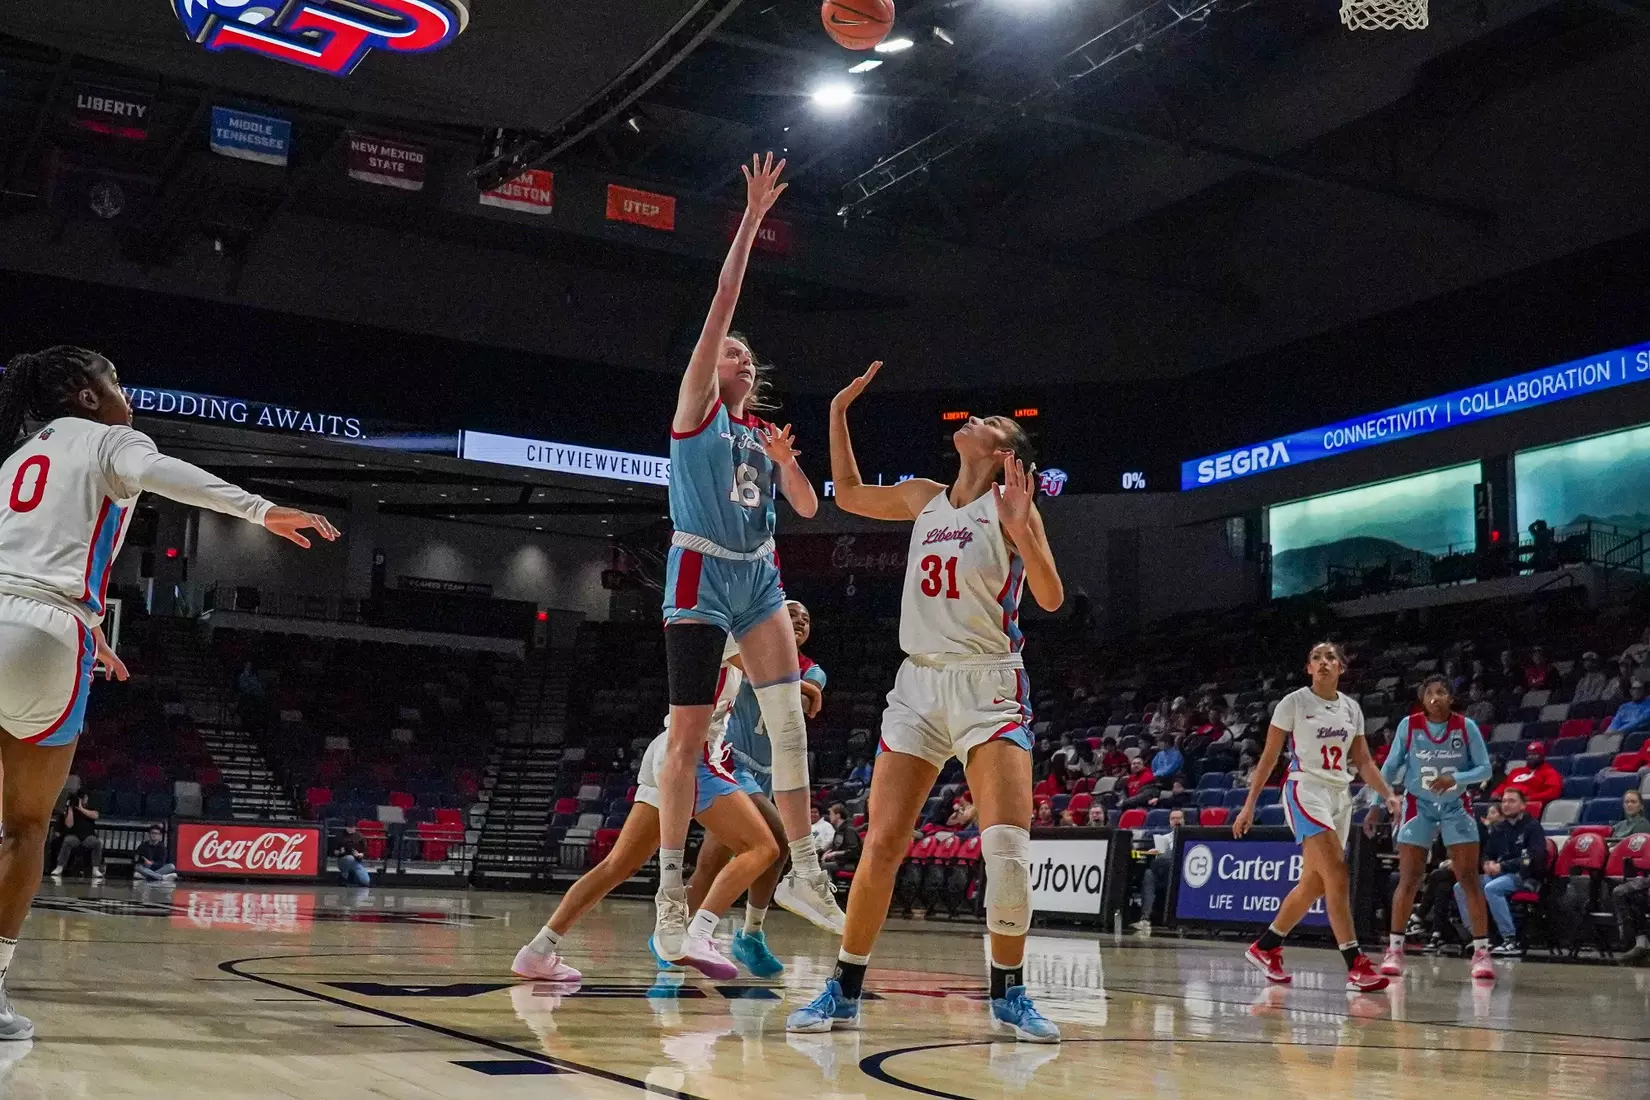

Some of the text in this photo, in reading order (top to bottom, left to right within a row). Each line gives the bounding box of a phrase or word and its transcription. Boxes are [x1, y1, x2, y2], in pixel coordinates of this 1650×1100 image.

[77, 94, 147, 118] LIBERTY
[228, 117, 273, 135] MIDDLE
[216, 128, 283, 149] TENNESSEE
[351, 140, 423, 163] NEW MEXICO
[369, 156, 405, 172] STATE
[511, 172, 533, 186] AM
[623, 199, 660, 216] UTEP
[759, 228, 776, 241] KU
[1323, 404, 1438, 450] CONNECTIVITY
[1459, 360, 1611, 416] COLLABORATION
[1636, 350, 1650, 372] S
[257, 406, 366, 438] AWAITS.
[943, 411, 969, 420] LIBERTY
[1198, 441, 1290, 484] SEGRA
[9, 454, 51, 513] 0
[1122, 471, 1146, 490] 0%
[922, 526, 974, 550] Liberty
[921, 554, 960, 600] 31
[1316, 726, 1349, 743] Liberty
[1320, 745, 1343, 771] 12
[191, 830, 308, 871] Coca-Cola
[1029, 857, 1103, 895] utova
[1217, 853, 1285, 882] Carter
[1208, 894, 1235, 910] LIFE
[1243, 895, 1281, 912] LIVED
